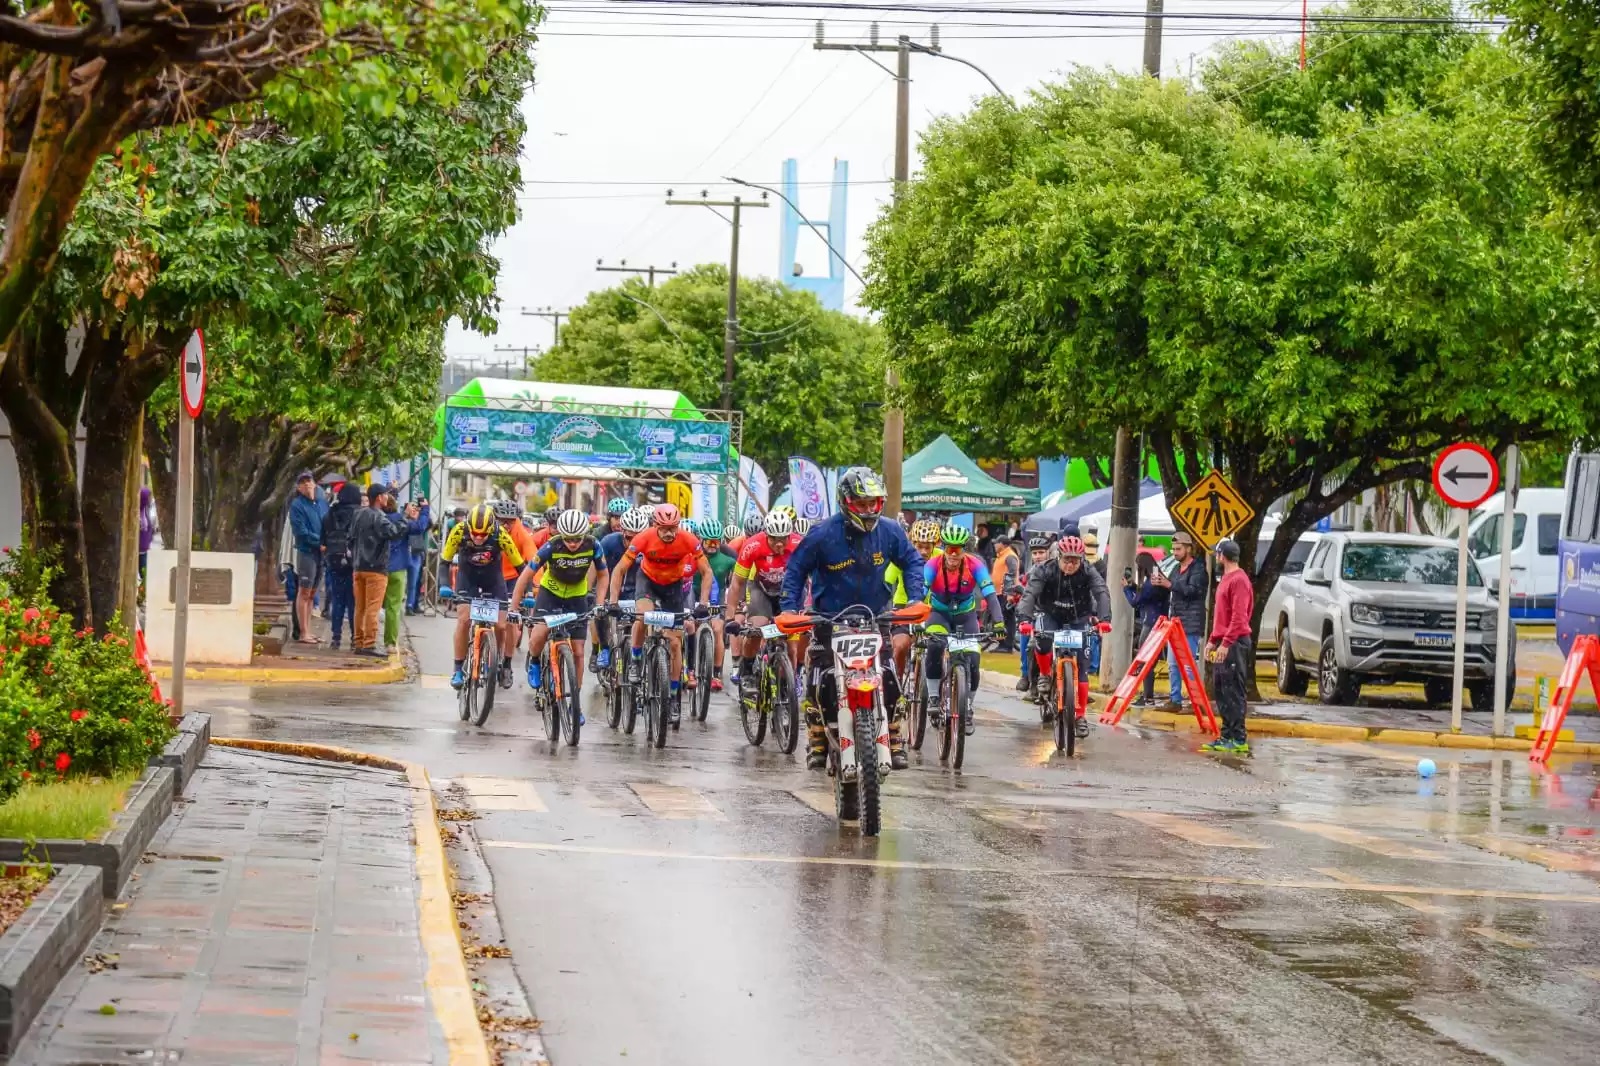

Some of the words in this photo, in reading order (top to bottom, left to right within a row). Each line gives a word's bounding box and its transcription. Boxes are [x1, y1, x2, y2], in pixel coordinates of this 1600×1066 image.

[552, 442, 593, 452] BODOQUENA
[914, 495, 961, 503] BODOQUENA
[963, 496, 981, 504] BIKE
[983, 497, 1003, 505] TEAM
[836, 637, 878, 658] 425
